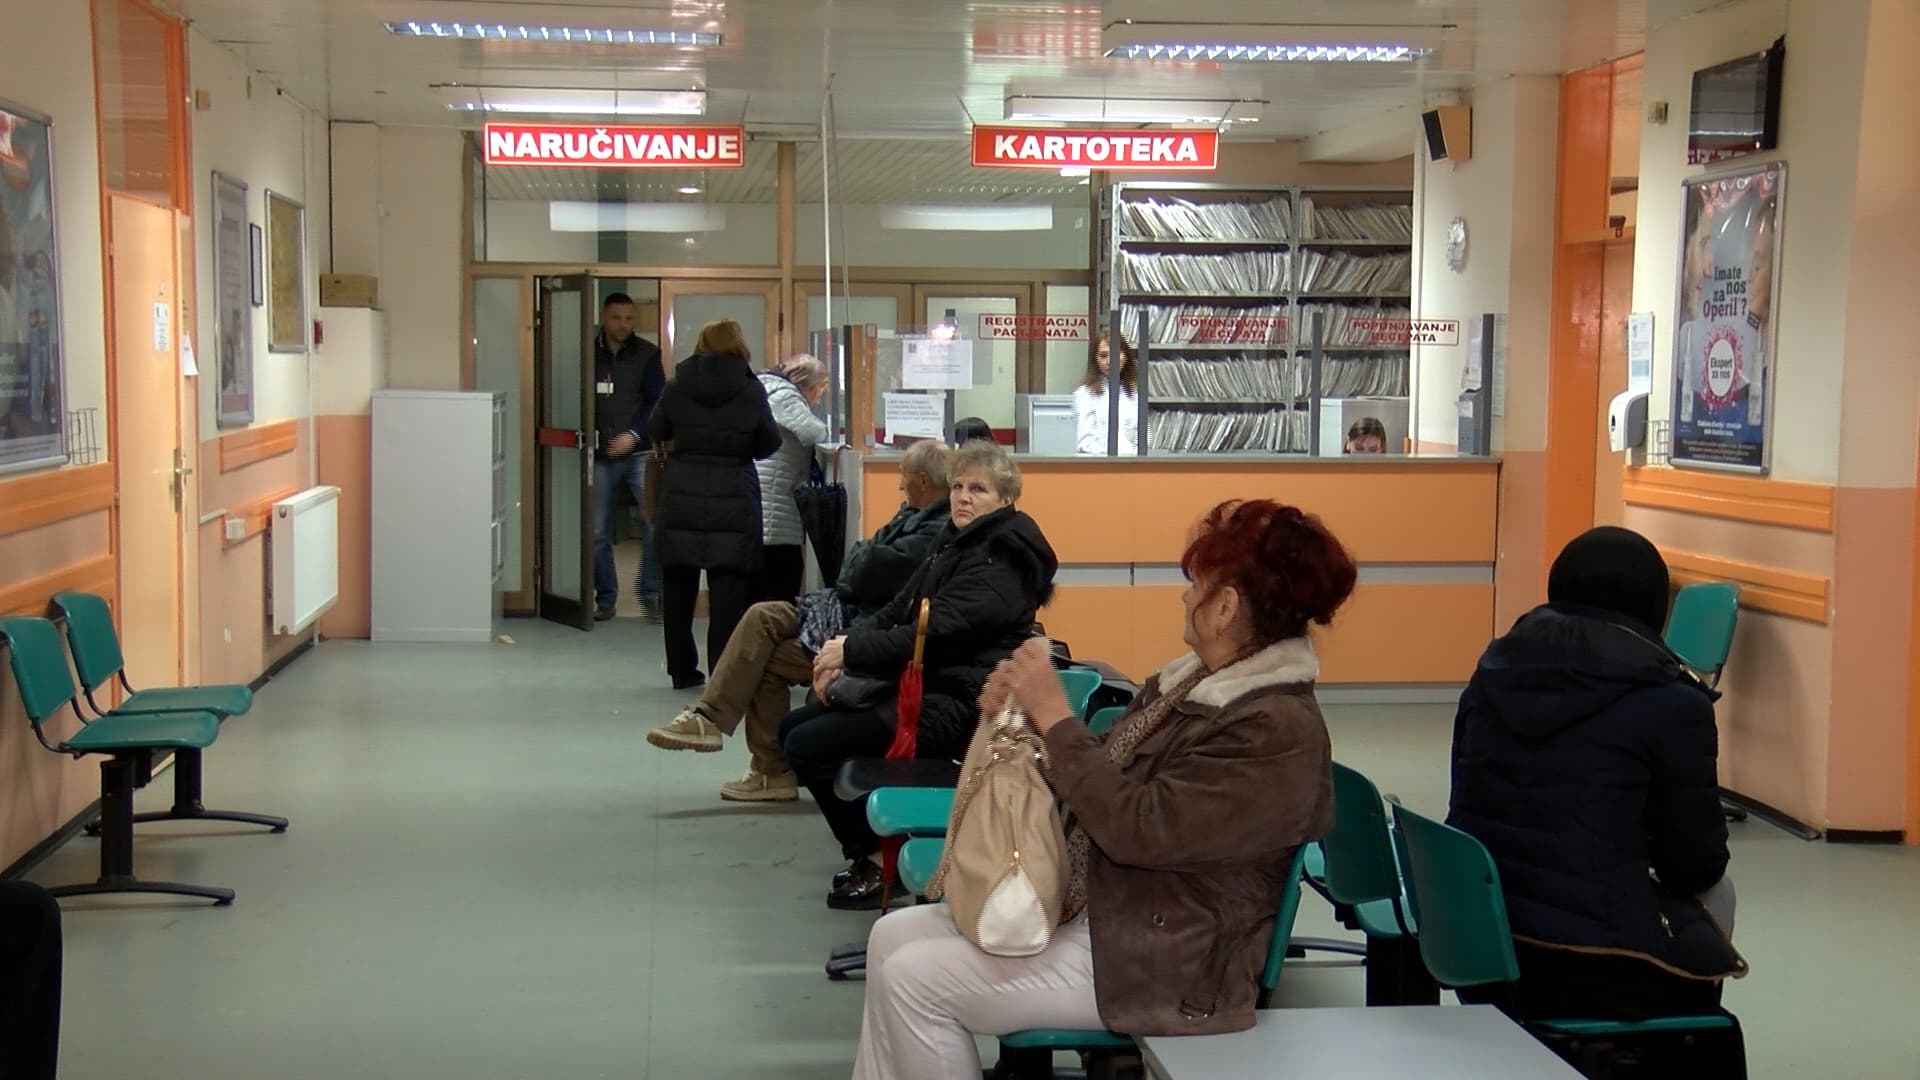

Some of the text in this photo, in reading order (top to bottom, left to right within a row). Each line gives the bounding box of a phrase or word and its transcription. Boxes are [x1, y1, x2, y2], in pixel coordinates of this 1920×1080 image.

[490, 128, 739, 160] NARUČIVANJE
[994, 135, 1199, 162] KARTOTEKA
[1714, 266, 1742, 281] Imate
[1713, 281, 1747, 303] za nos
[985, 317, 1087, 327] REGISTRACIJA
[1181, 318, 1285, 329] POPUNJAVANJE
[1353, 321, 1456, 332] POPUNJAVANJE
[993, 328, 1079, 337] PACIJENATA
[1371, 332, 1437, 342] RECEPATA
[1710, 357, 1733, 369] Ekspert
[1711, 370, 1731, 379] za nos
